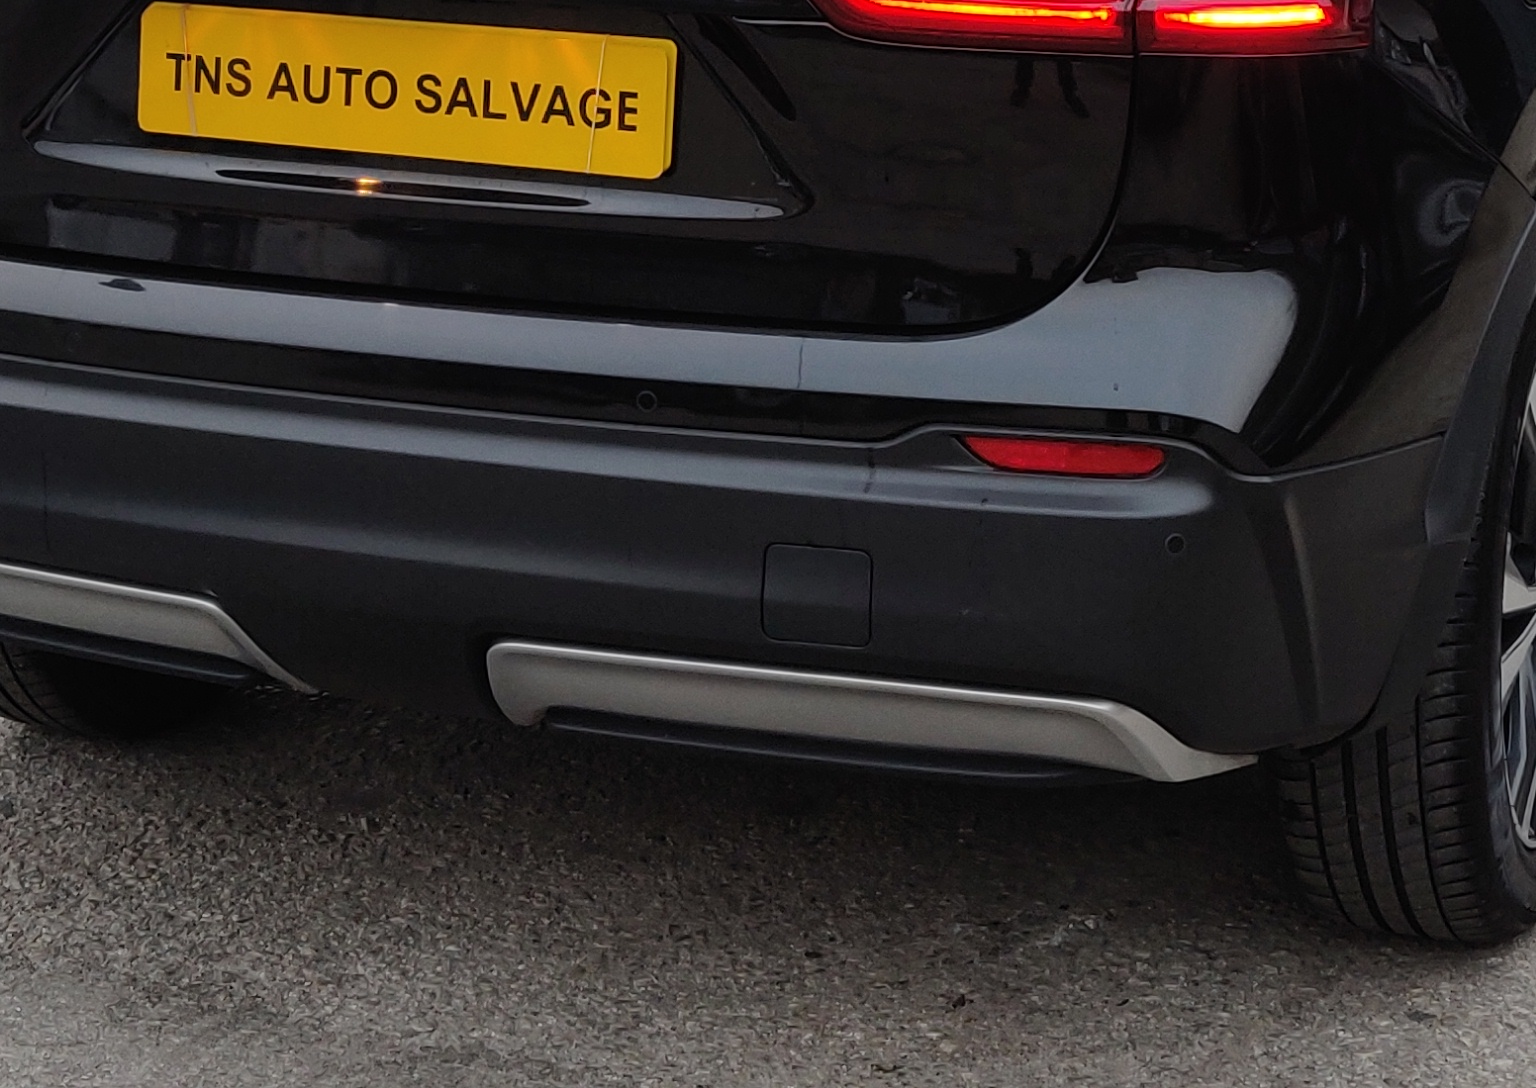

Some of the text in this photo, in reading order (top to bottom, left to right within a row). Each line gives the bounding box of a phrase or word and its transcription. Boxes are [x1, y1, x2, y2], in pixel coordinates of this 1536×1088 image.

[166, 52, 639, 132] TNS AUTO SALVAGE
